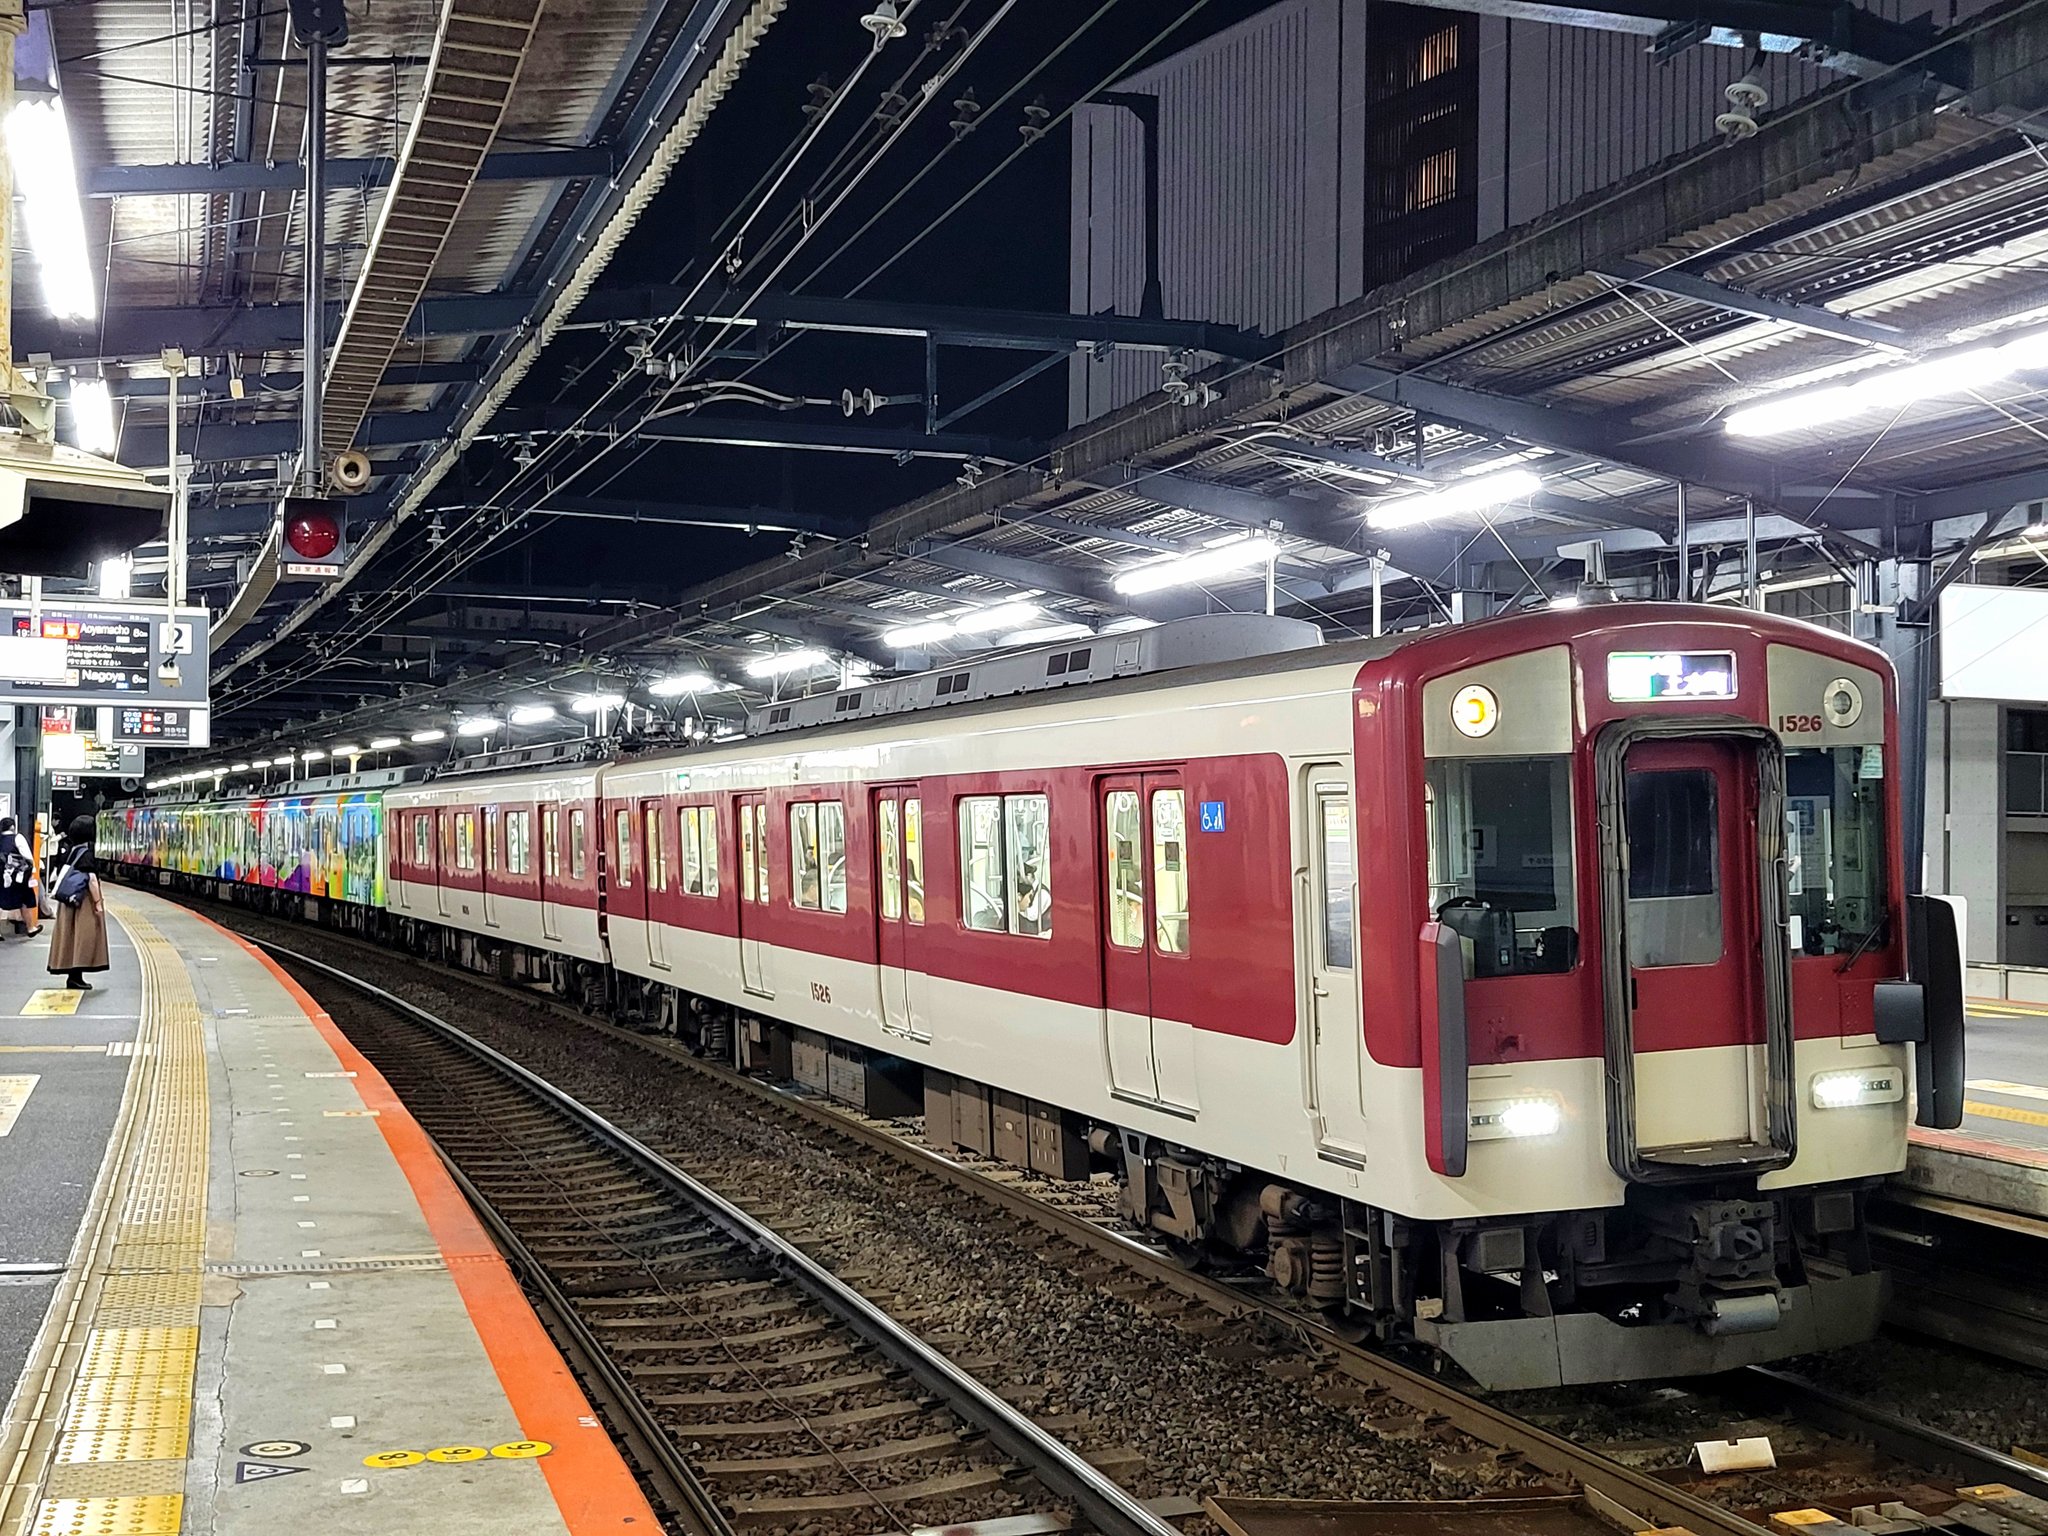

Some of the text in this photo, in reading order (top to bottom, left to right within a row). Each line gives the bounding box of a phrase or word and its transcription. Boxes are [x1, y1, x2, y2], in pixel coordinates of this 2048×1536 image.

[80, 623, 130, 636] Aoyamacho
[82, 669, 126, 683] Nagoya
[1779, 715, 1822, 732] 1526
[810, 981, 831, 1004] 1526
[378, 1452, 409, 1461] 8
[246, 1467, 279, 1475] 3
